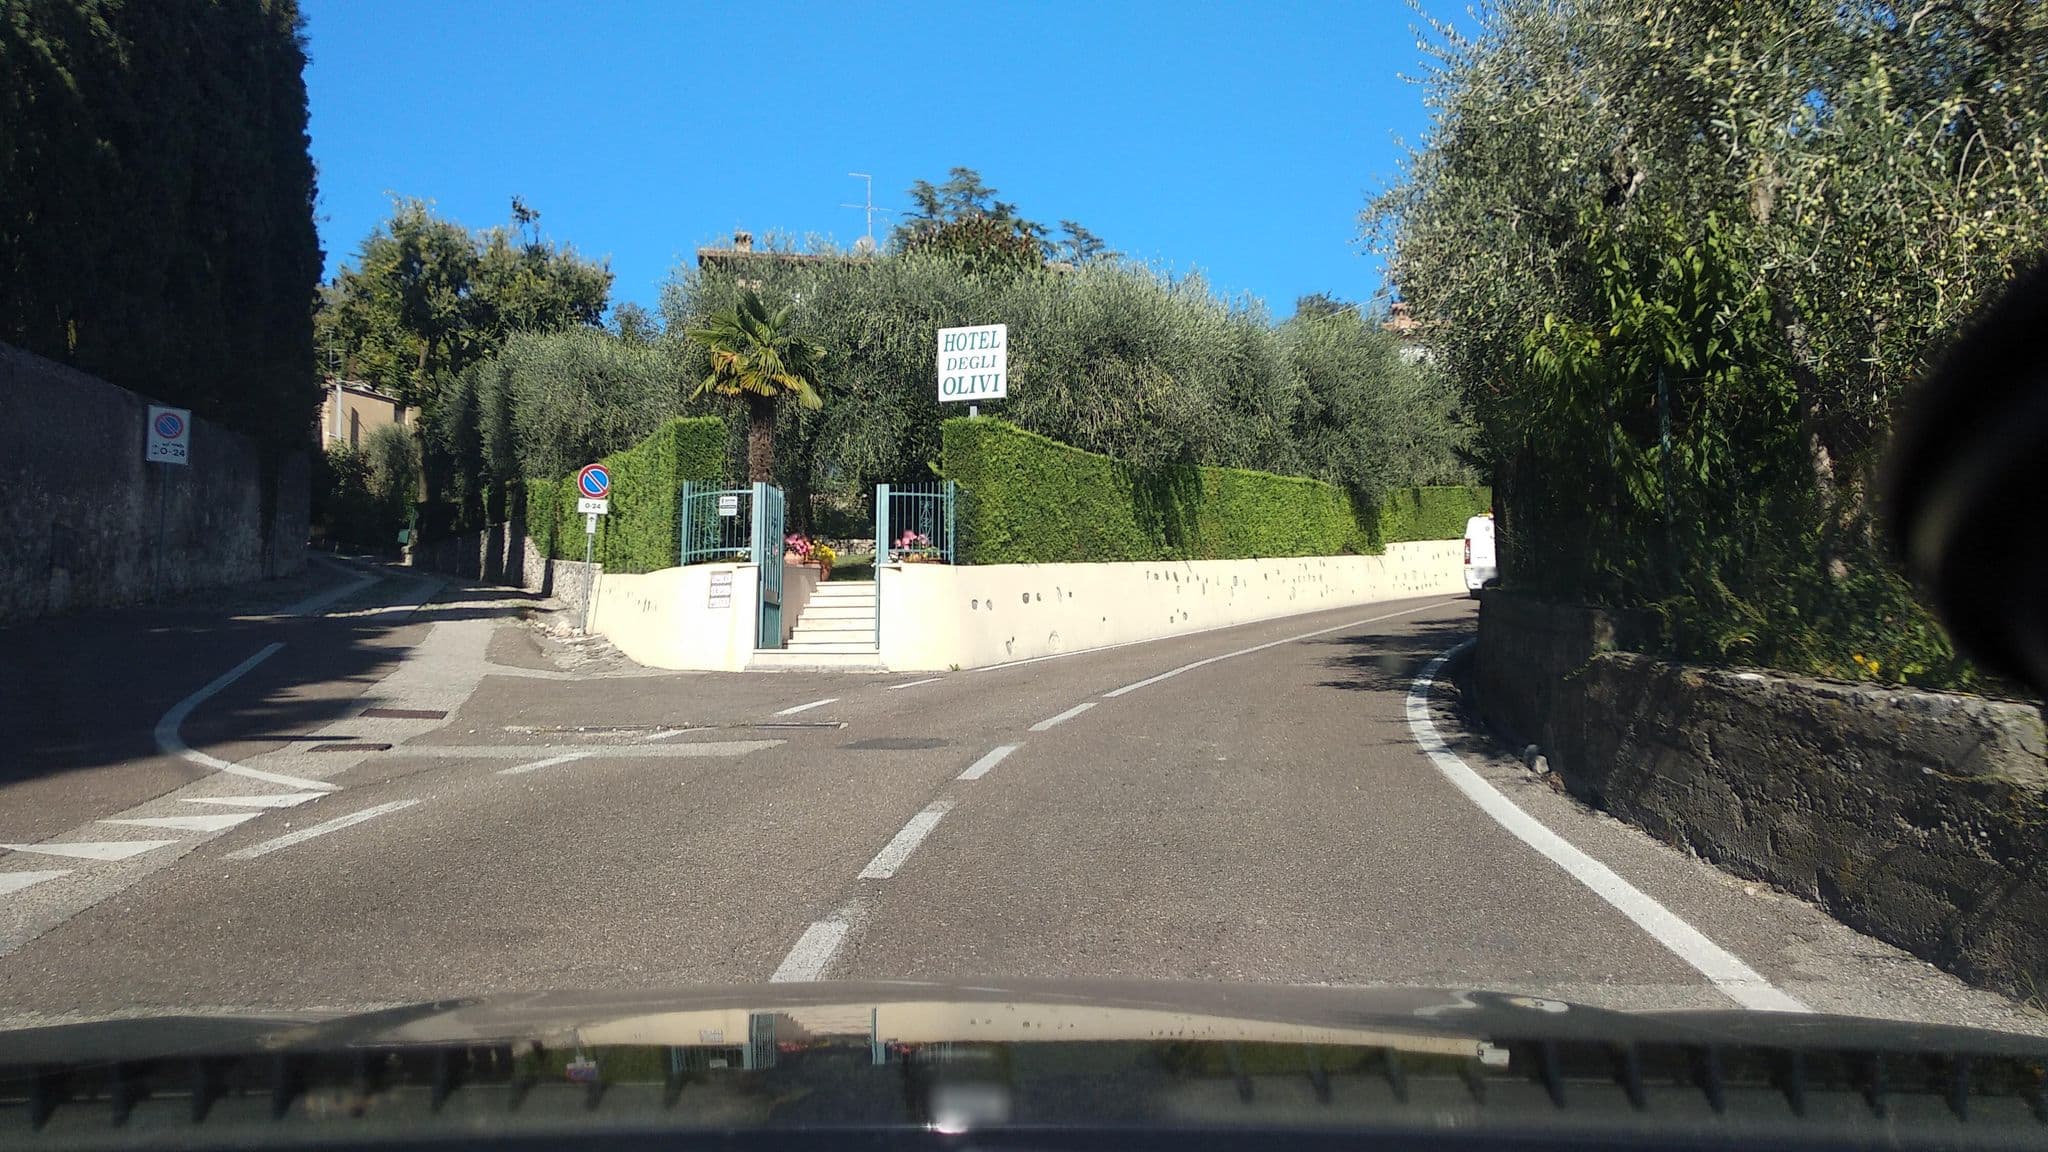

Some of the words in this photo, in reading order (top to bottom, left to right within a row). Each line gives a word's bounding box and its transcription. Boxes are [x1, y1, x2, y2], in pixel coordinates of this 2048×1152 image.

[943, 330, 1001, 352] HOTEL
[946, 354, 997, 371] DEGLI
[943, 373, 1001, 396] OLIVI
